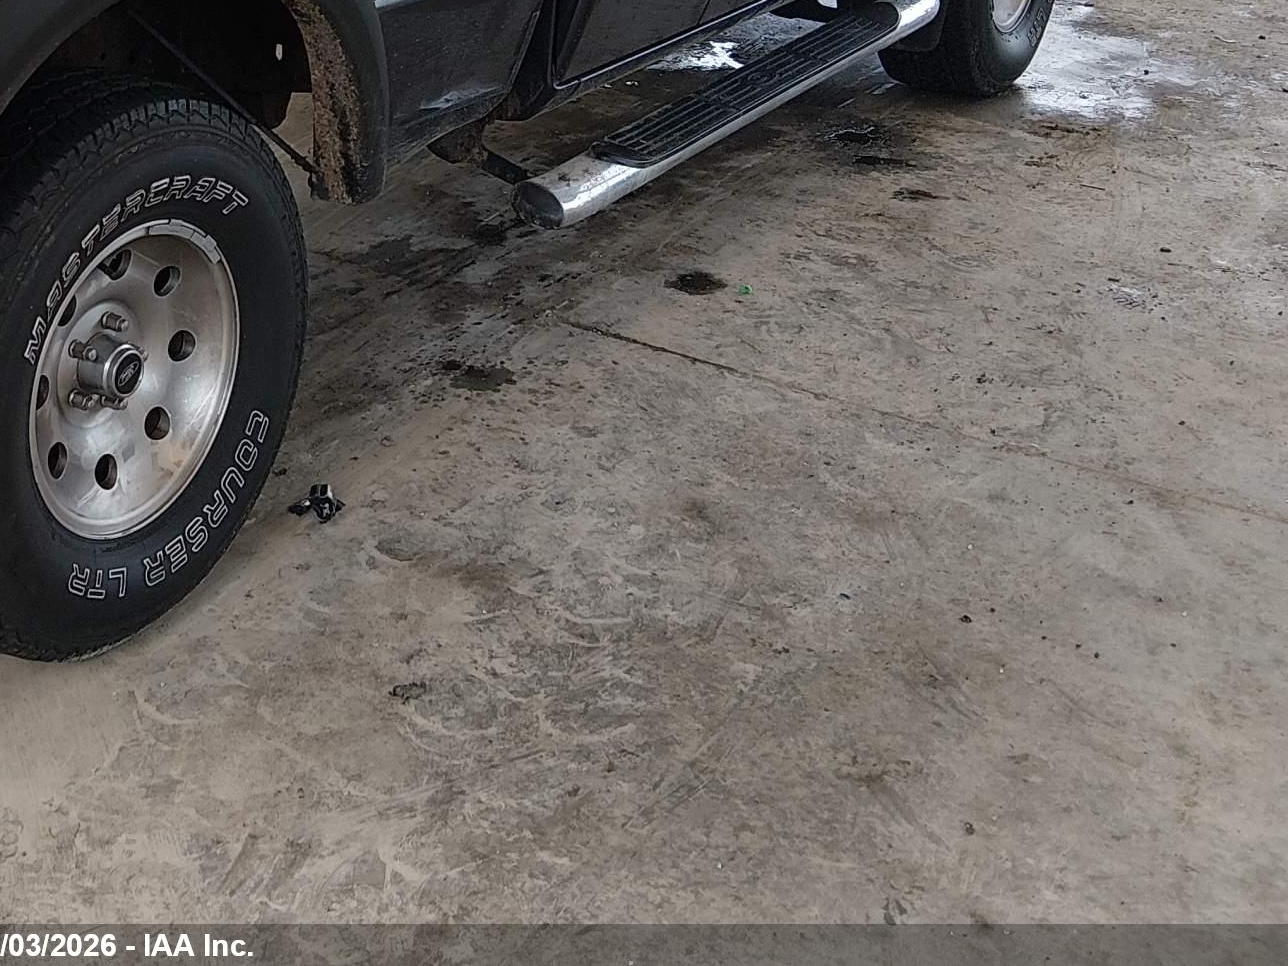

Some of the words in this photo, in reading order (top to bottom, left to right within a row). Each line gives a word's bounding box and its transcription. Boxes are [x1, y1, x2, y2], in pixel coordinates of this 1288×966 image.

[24, 174, 249, 365] MASTERCRAFT
[67, 563, 128, 599] LTR
[143, 410, 269, 586] COURSER
